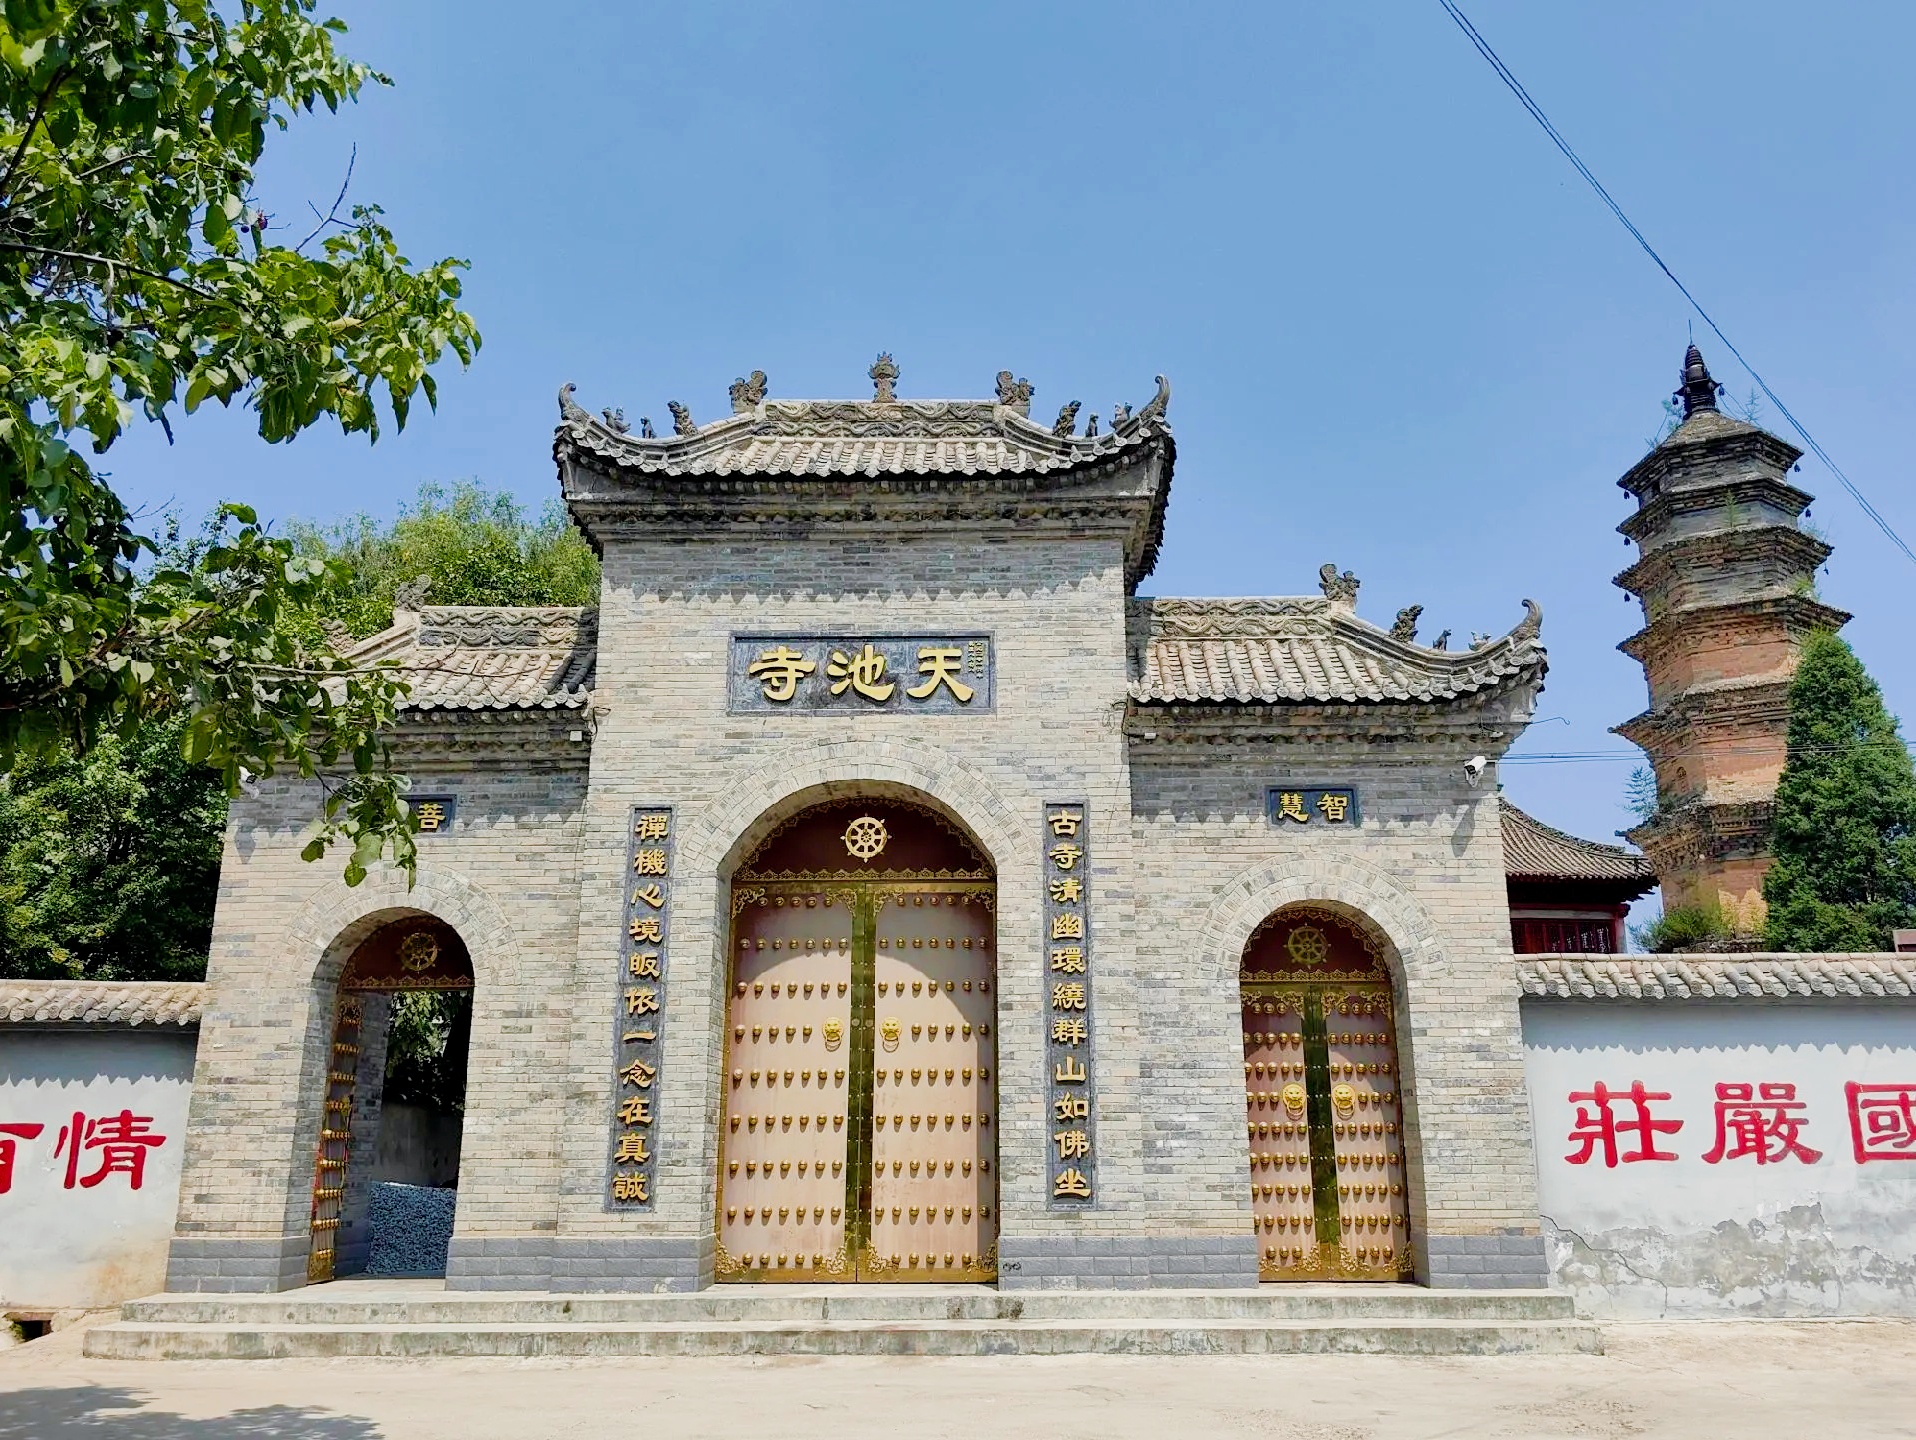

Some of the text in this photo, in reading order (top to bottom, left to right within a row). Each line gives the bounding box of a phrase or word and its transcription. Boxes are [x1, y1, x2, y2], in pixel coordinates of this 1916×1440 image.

[749, 644, 974, 702] 天池寺
[1278, 793, 1348, 822] 智慧
[1048, 810, 1091, 1198] 古寺清幽環繞群山如佛坐
